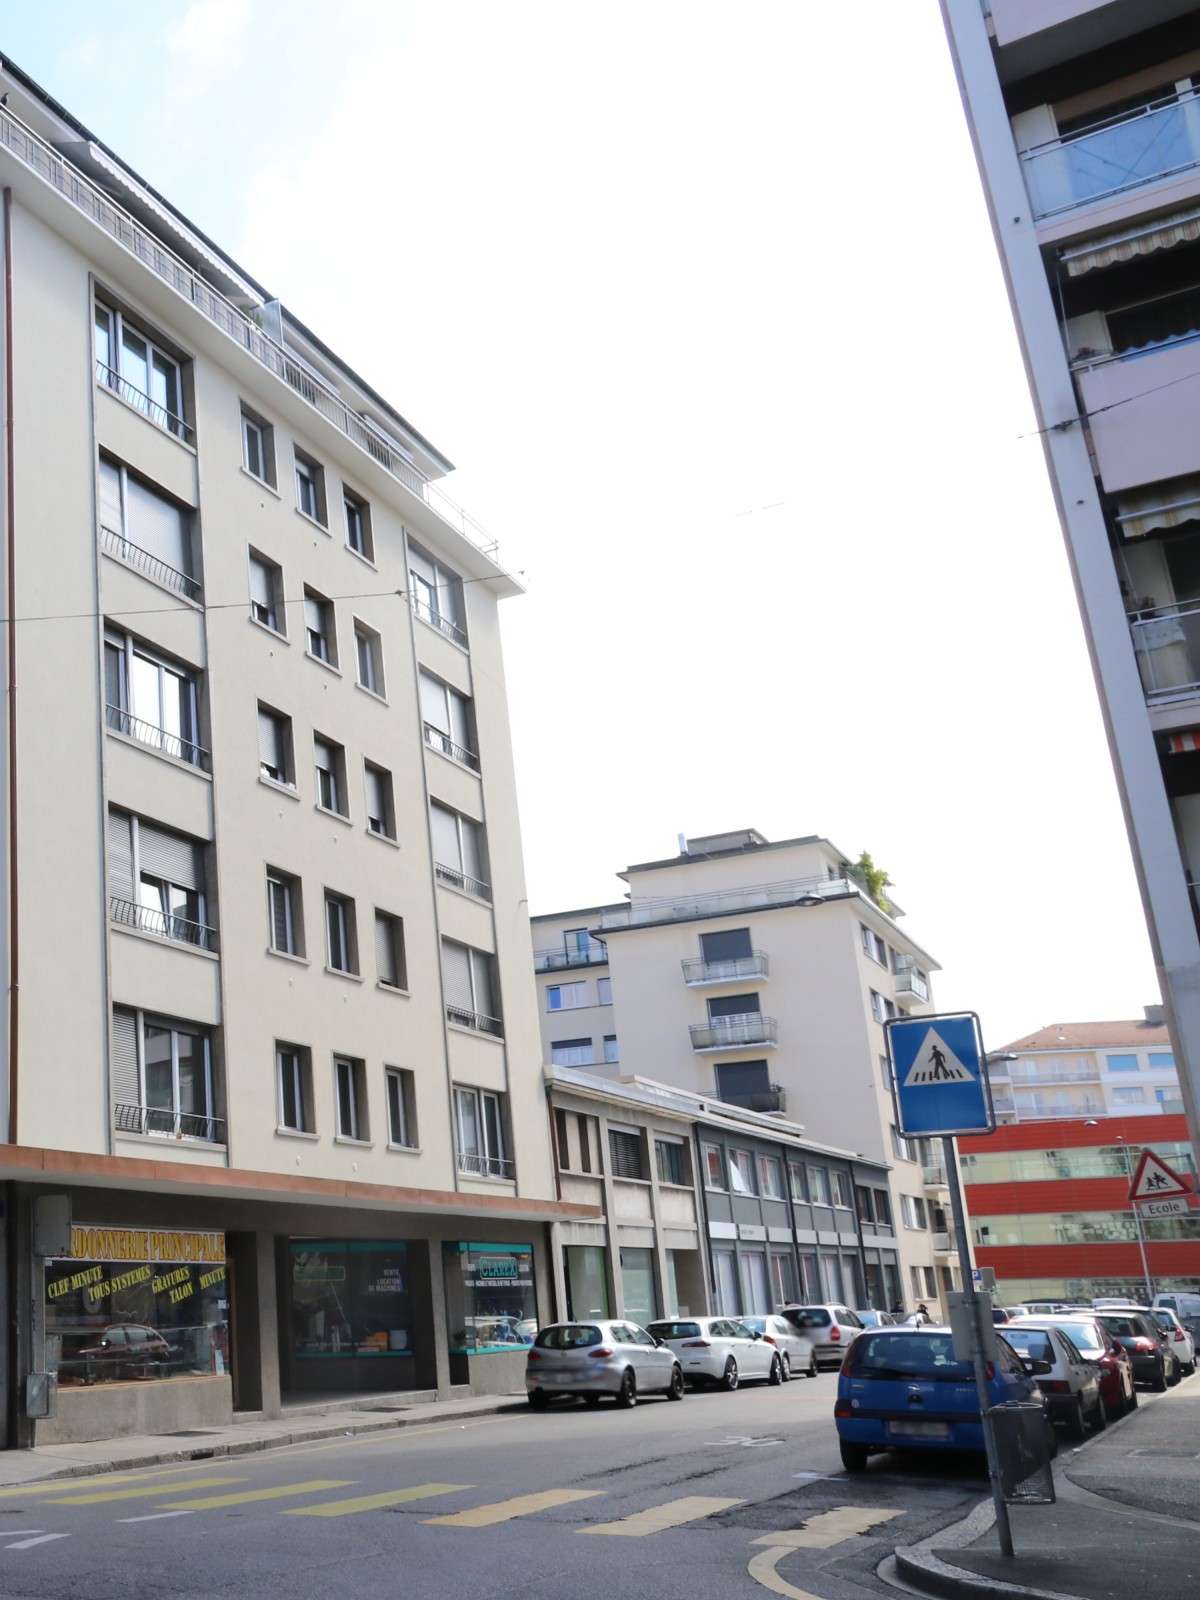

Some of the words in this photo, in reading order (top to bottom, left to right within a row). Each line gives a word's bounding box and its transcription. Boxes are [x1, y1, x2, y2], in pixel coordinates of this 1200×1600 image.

[1148, 1202, 1180, 1214] Ecole
[71, 1228, 149, 1260] DONNERIE
[150, 1231, 225, 1262] PRINCIPALE
[48, 1276, 69, 1299] CLEF
[71, 1265, 104, 1290] MINUTE
[88, 1279, 111, 1302] TOUS
[110, 1264, 151, 1293] SYSTEMES
[151, 1266, 191, 1294] GRAVURES
[199, 1266, 226, 1290] MINUTE
[169, 1281, 194, 1305] TALON
